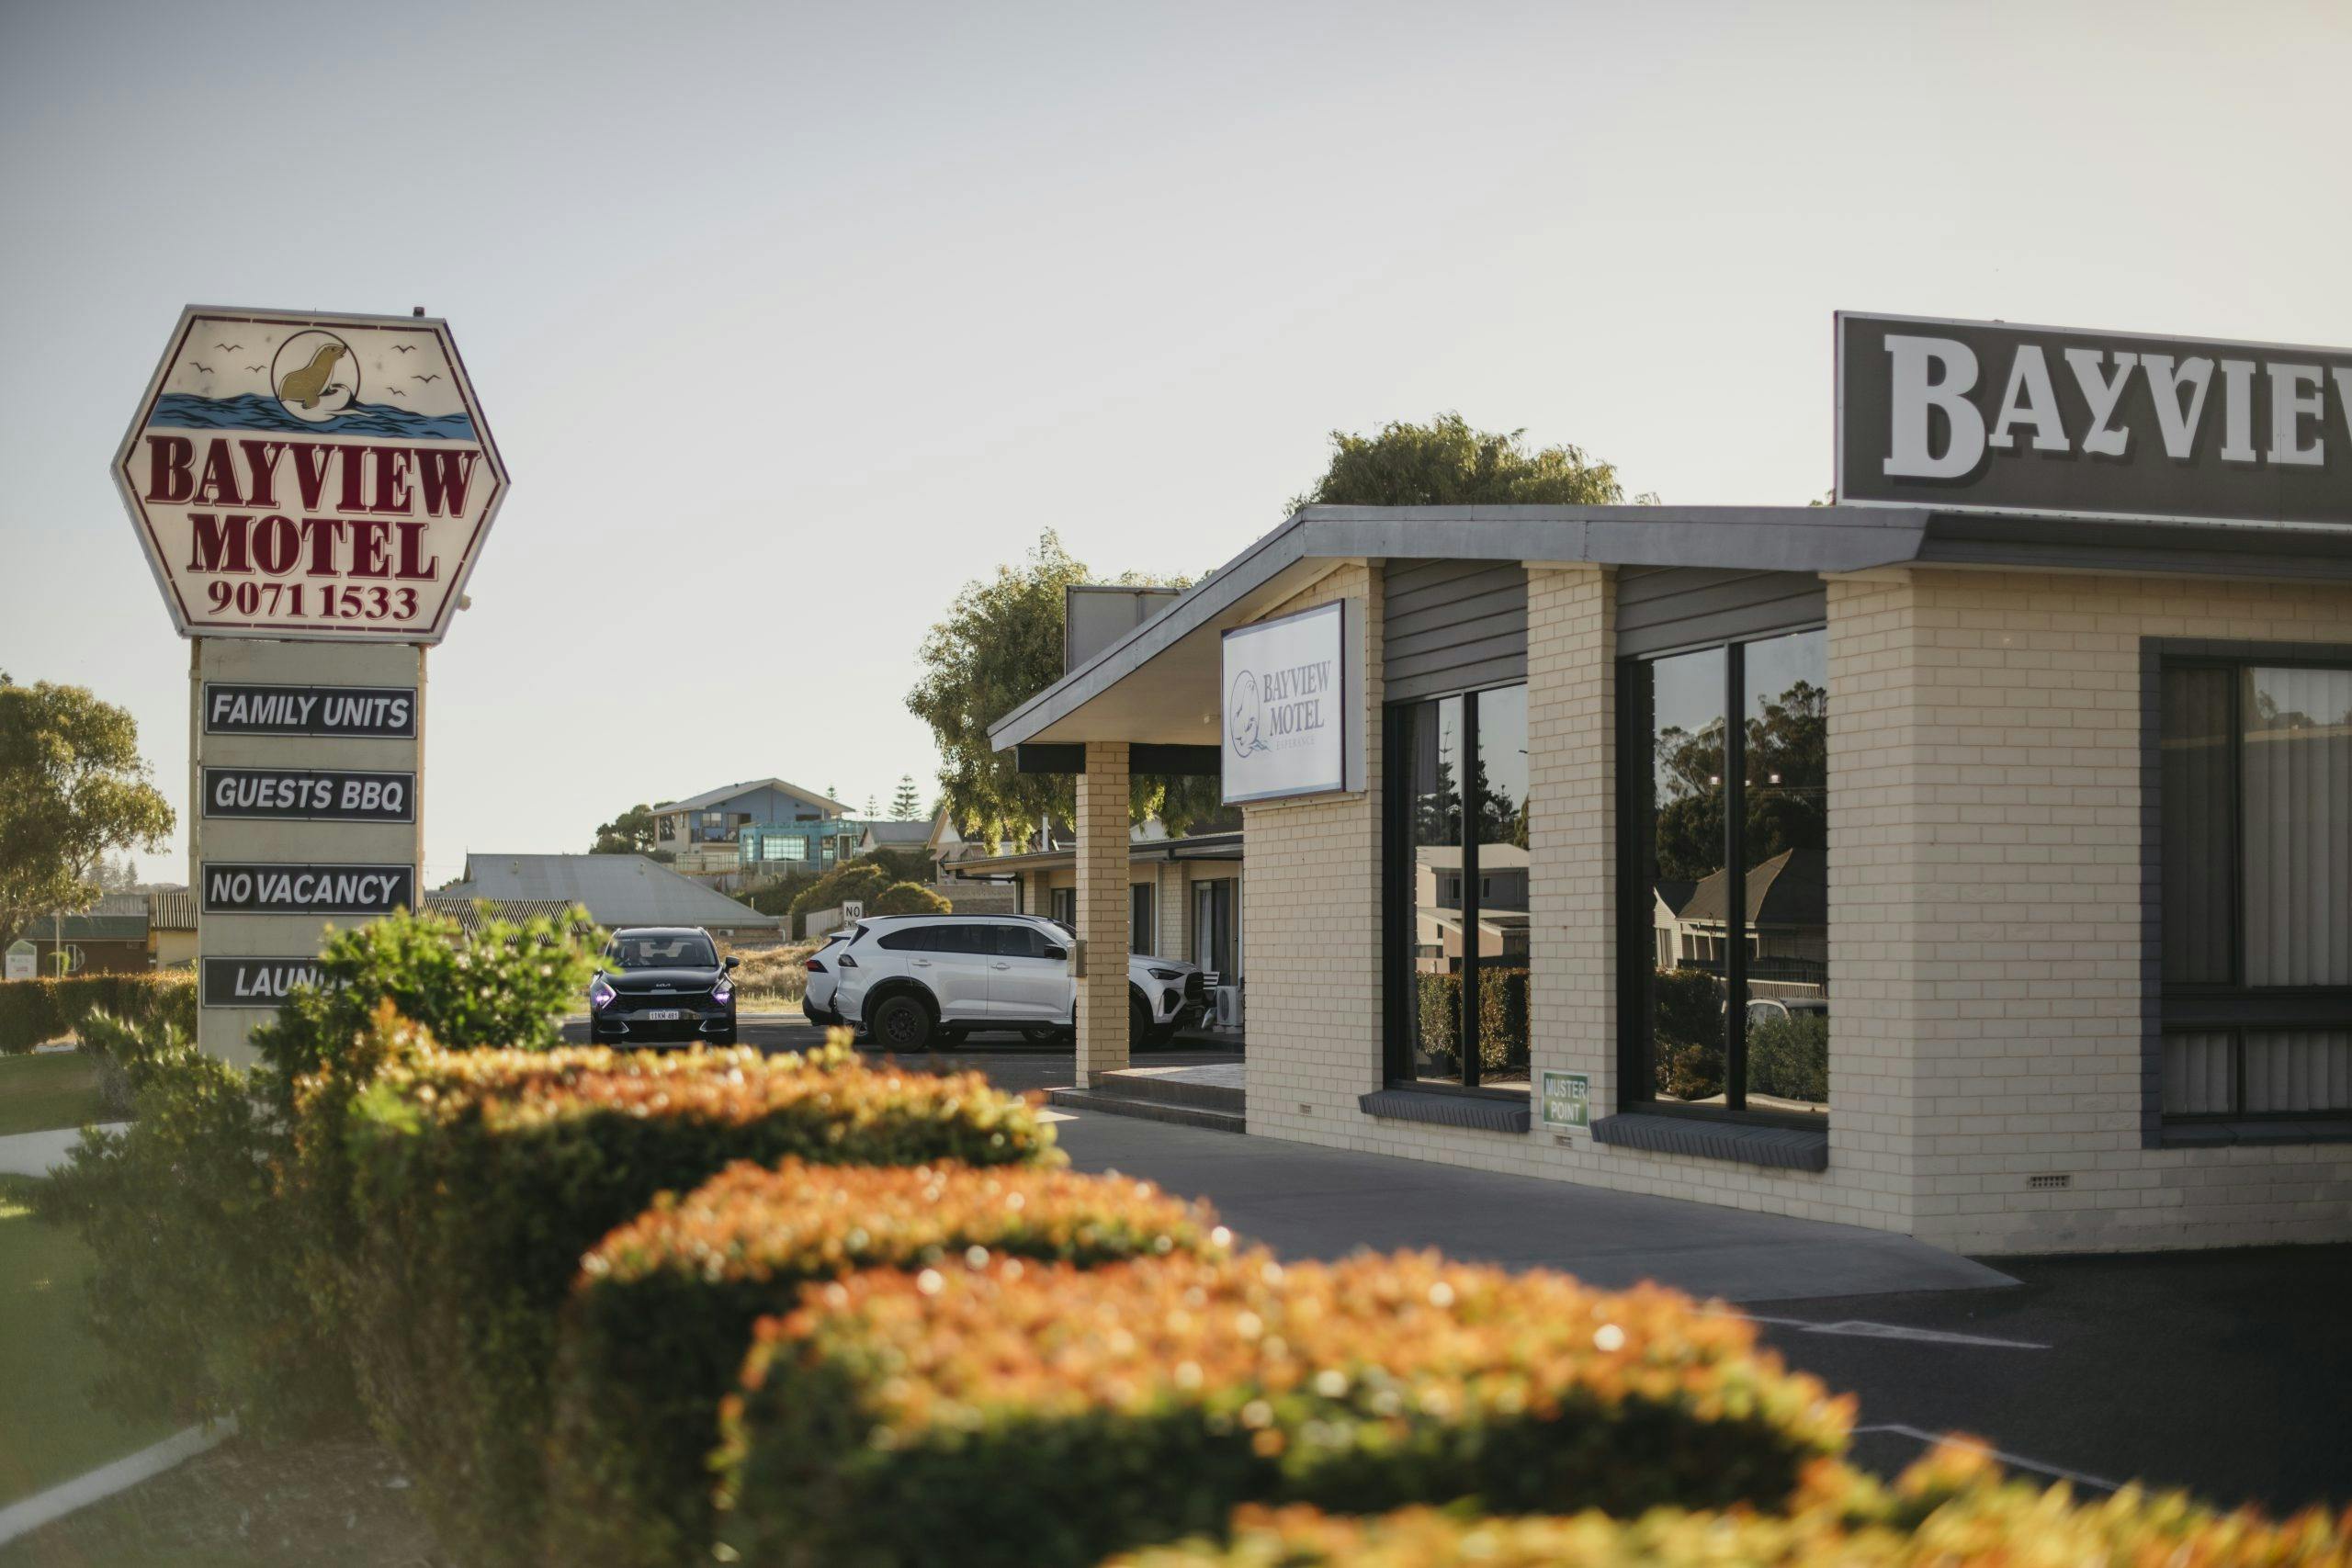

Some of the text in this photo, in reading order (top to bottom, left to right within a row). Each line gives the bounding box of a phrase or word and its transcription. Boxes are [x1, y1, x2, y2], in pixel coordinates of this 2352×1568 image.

[145, 434, 482, 519] BAYVIEW
[187, 513, 439, 582] MOTEL
[208, 581, 419, 621] 9071 1533
[1263, 660, 1331, 703] BAYVIEW
[211, 694, 410, 728] FAMILY UNITS
[1270, 699, 1325, 737] MOTEL
[215, 777, 404, 813] GUESTS BBQ
[210, 874, 401, 905] NO VACANCY
[845, 906, 861, 918] NO
[234, 967, 355, 998] LAUN
[1545, 1077, 1587, 1100] MUSTER
[1550, 1100, 1581, 1122] POINT
